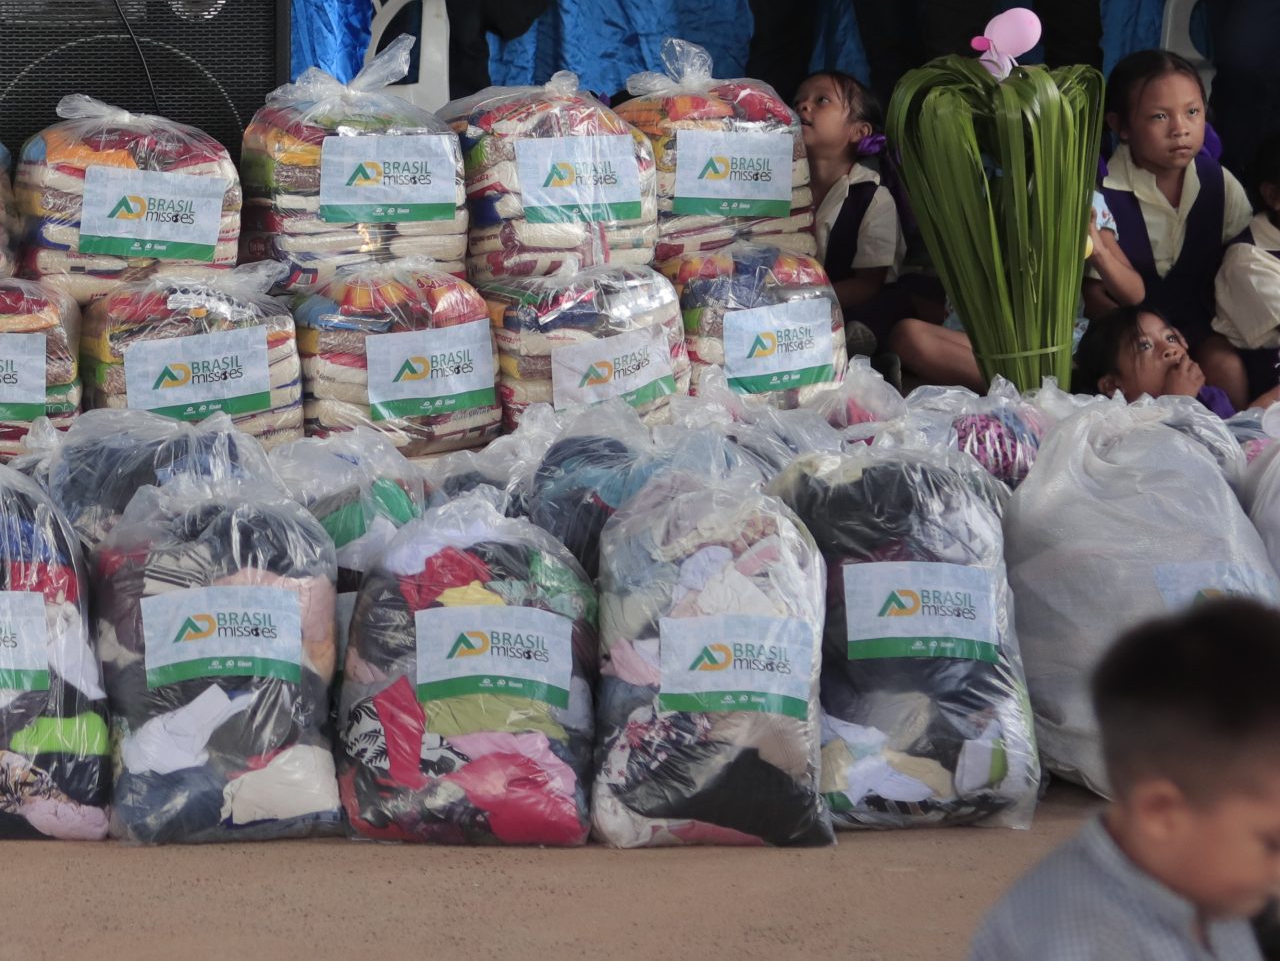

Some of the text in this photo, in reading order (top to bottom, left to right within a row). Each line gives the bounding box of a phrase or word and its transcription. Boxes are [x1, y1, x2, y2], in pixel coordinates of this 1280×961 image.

[383, 161, 432, 175] BRASIL
[731, 157, 773, 171] BRASIL
[148, 197, 195, 214] BRASIL
[777, 325, 814, 341] BRASIL
[192, 355, 241, 372] BRASIL
[430, 348, 474, 366] BRASIL
[613, 345, 651, 368] BRASIL
[921, 590, 975, 607] BRASIL
[217, 612, 276, 627] BRASIL
[490, 631, 547, 650] BRASIL
[733, 643, 791, 662] BRASIL
